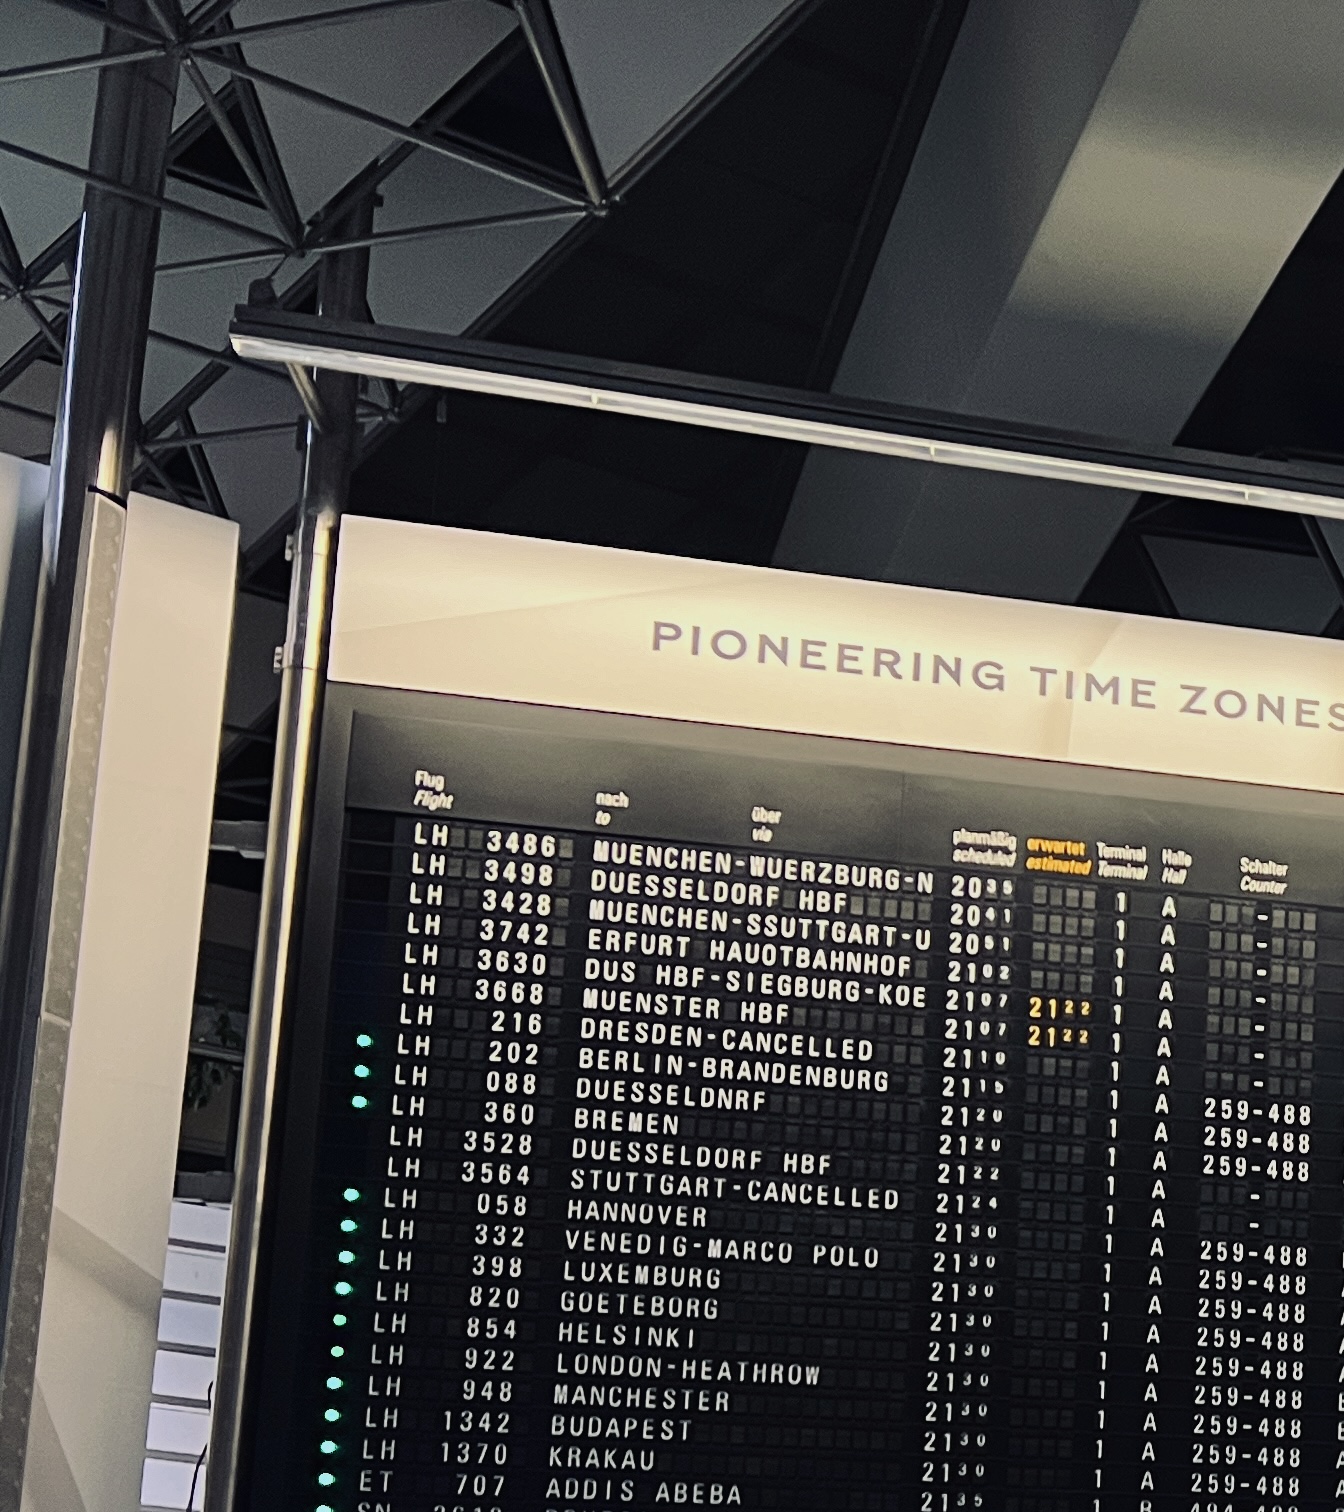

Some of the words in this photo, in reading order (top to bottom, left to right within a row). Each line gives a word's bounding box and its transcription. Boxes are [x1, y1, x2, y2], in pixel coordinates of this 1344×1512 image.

[652, 620, 1005, 692] PIONEERING
[1029, 665, 1156, 710] TIME
[415, 770, 444, 790] Flug
[414, 790, 453, 810] Flight
[596, 791, 629, 808] nach
[596, 809, 611, 826] to
[751, 807, 782, 824] über
[752, 827, 772, 843] via
[1027, 837, 1085, 856] erwartet
[1097, 842, 1147, 862] Terminal
[413, 821, 448, 847] LH
[485, 829, 556, 858] 3486
[591, 838, 934, 894] MUENCHEN-WUERZBURG-N
[1026, 856, 1091, 875] estimated
[1098, 862, 1148, 882] Terminal
[1240, 858, 1288, 878] Schalter
[1240, 876, 1287, 895] Counter
[487, 1039, 538, 1065] 202
[578, 1046, 889, 1092] BERLIN-BRANDENBURG
[1203, 1096, 1311, 1126] 259-488
[465, 1316, 515, 1339] 854
[557, 1321, 694, 1349] HELSINKI
[358, 1470, 389, 1492] ET
[456, 1473, 504, 1496] 707
[544, 1477, 633, 1502] ADDIS
[654, 1481, 741, 1505] ABEBA
